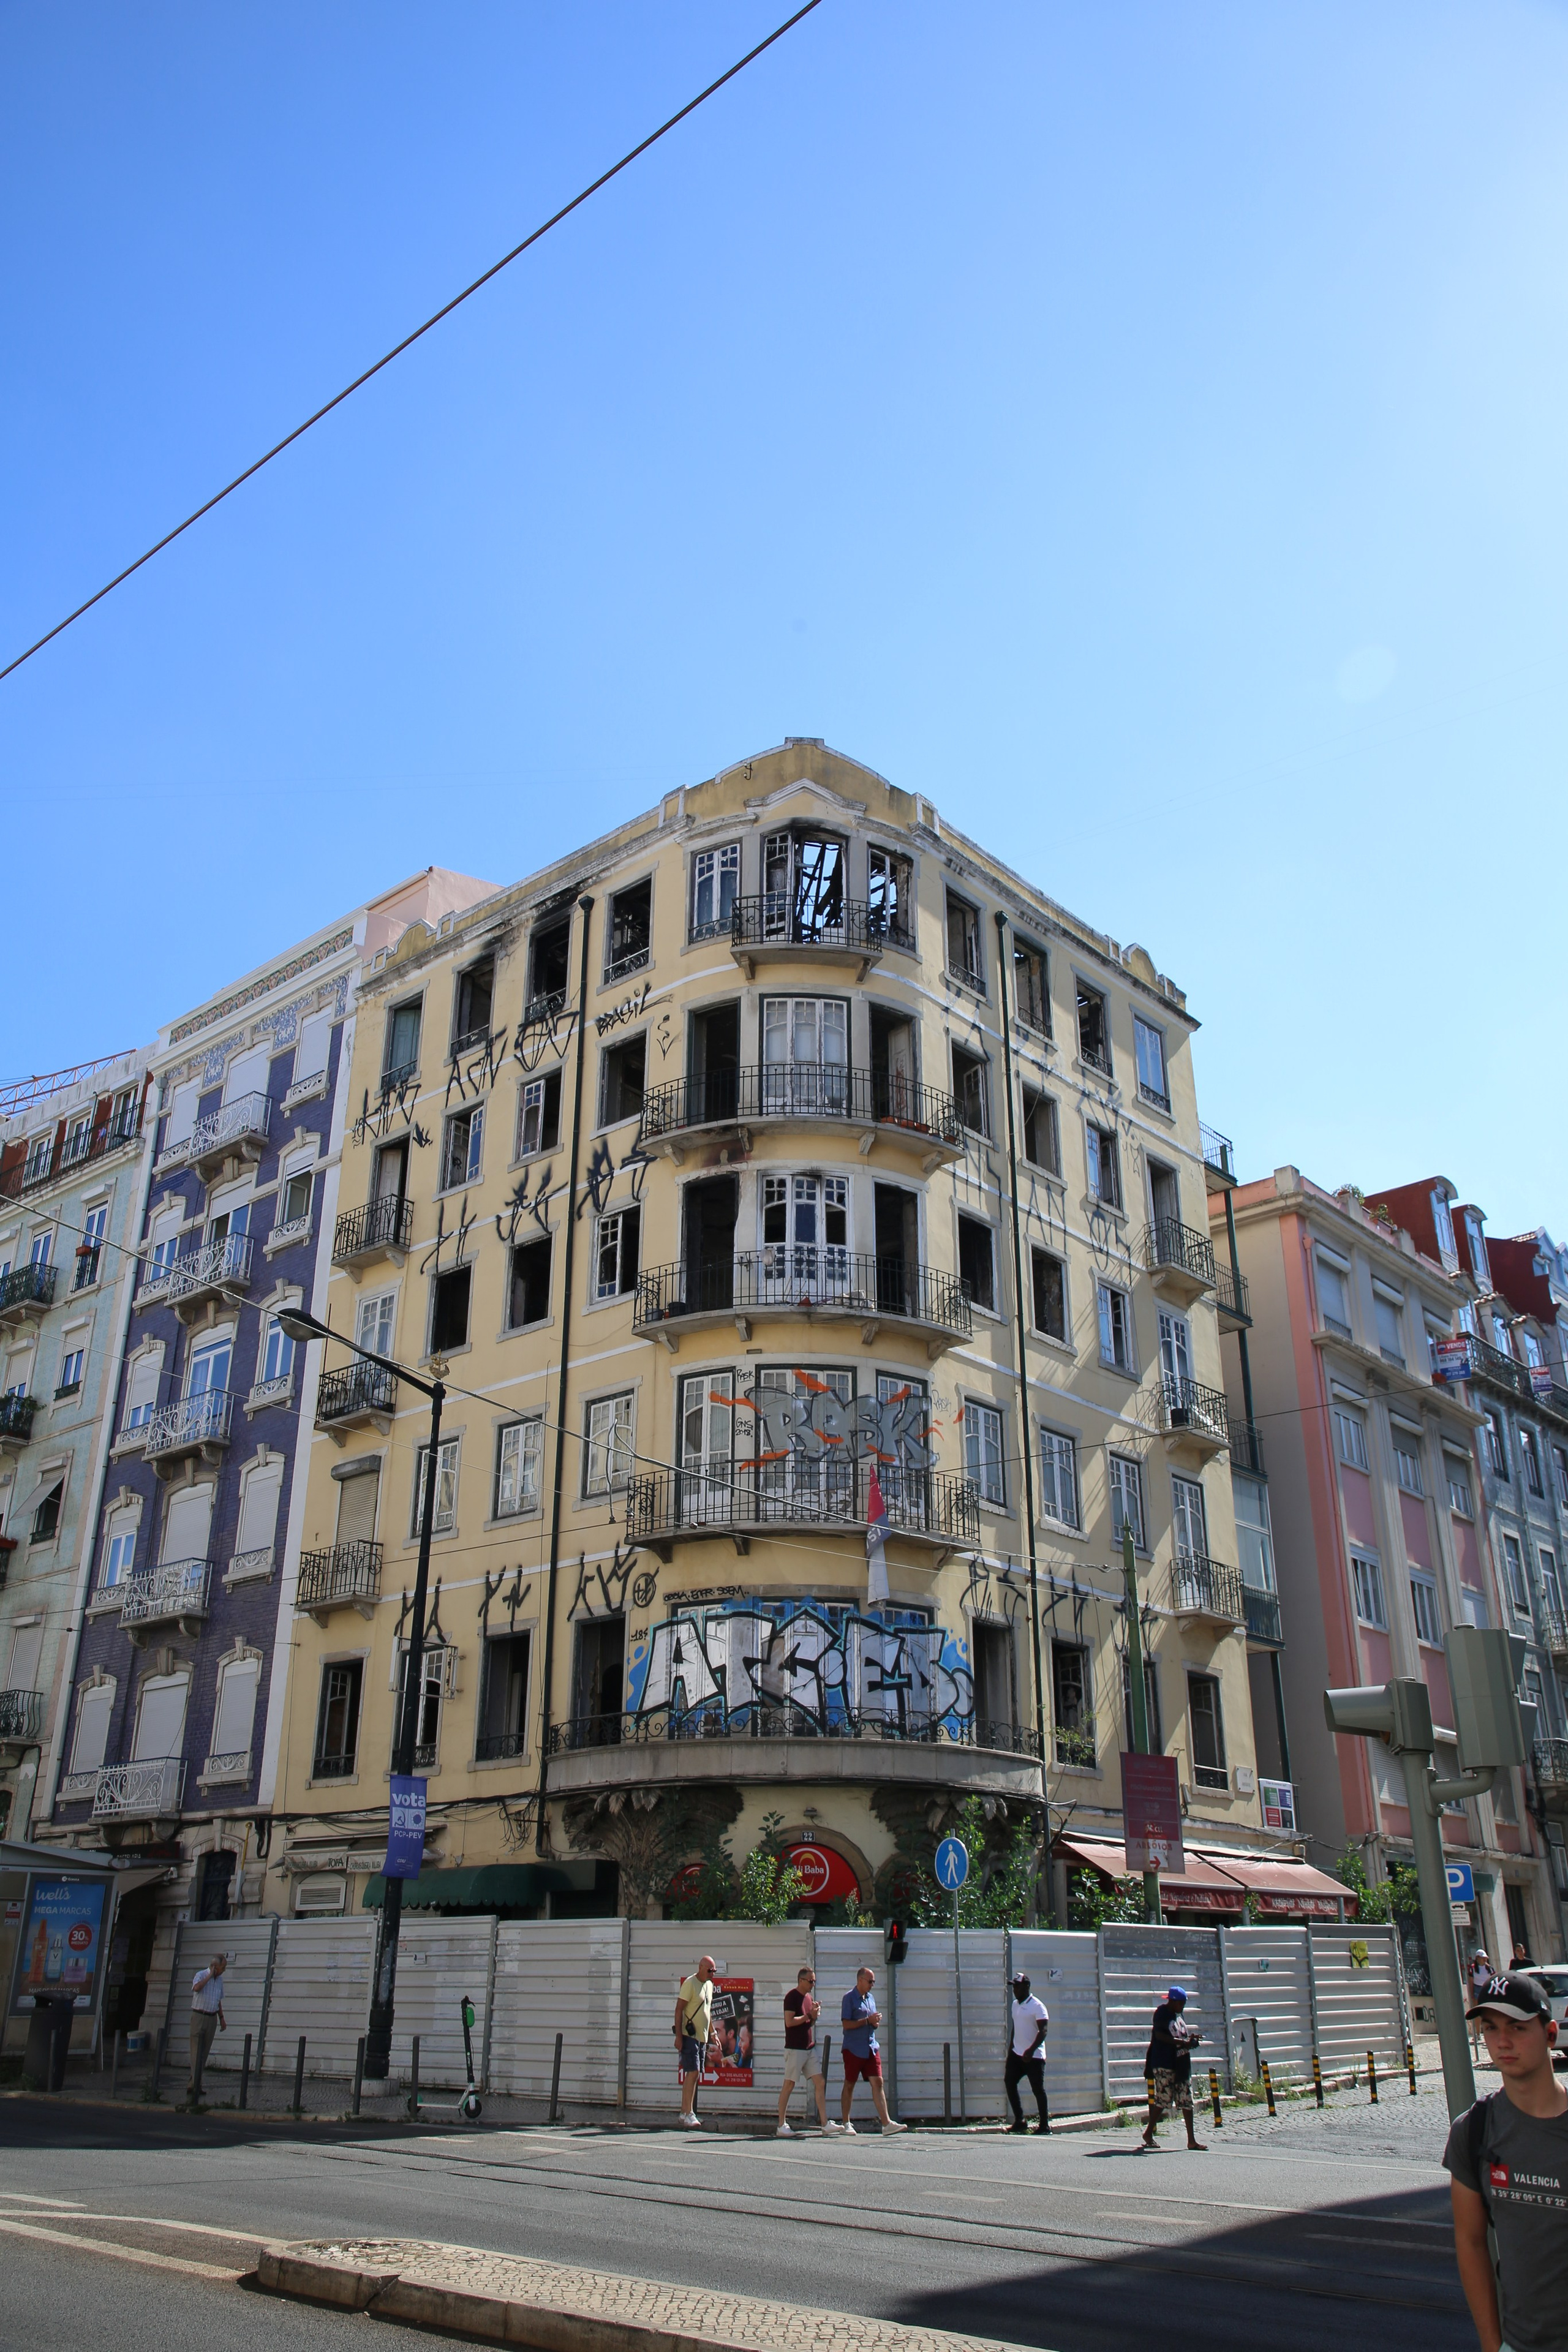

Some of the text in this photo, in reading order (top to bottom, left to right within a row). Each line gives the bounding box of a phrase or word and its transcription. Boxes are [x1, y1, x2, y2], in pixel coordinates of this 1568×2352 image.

[392, 1793, 426, 1807] vota
[394, 1830, 423, 1839] PCP-PEV
[803, 1832, 812, 1841] 22
[804, 1865, 824, 1874] Baba
[1446, 1868, 1464, 1899] P
[1488, 1976, 1509, 1996] NY
[1513, 2172, 1561, 2188] VALENCIA
